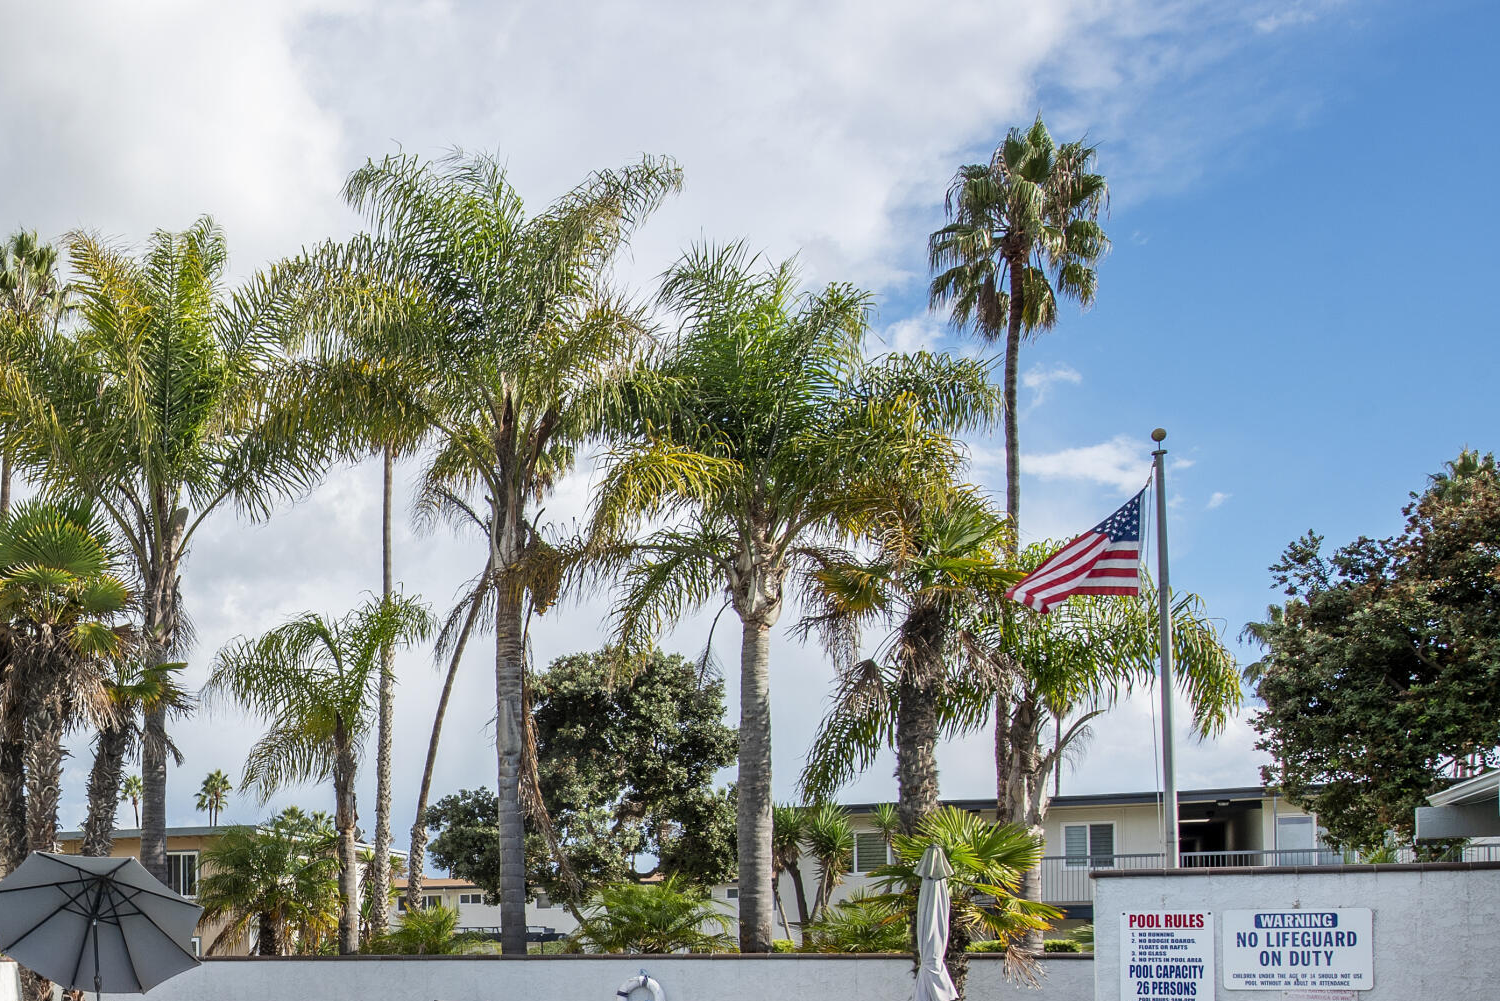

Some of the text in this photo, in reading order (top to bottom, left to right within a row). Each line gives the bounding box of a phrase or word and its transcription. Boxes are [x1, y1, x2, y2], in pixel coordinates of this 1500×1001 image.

[1129, 913, 1204, 928] POOL RULES
[1260, 914, 1333, 928] WARNING
[1236, 931, 1357, 947] NO LIFEGUARD
[1260, 950, 1333, 967] ON DUTY
[1129, 964, 1204, 979] POOL CAPACITY
[1137, 981, 1197, 995] 26 PERSONS
